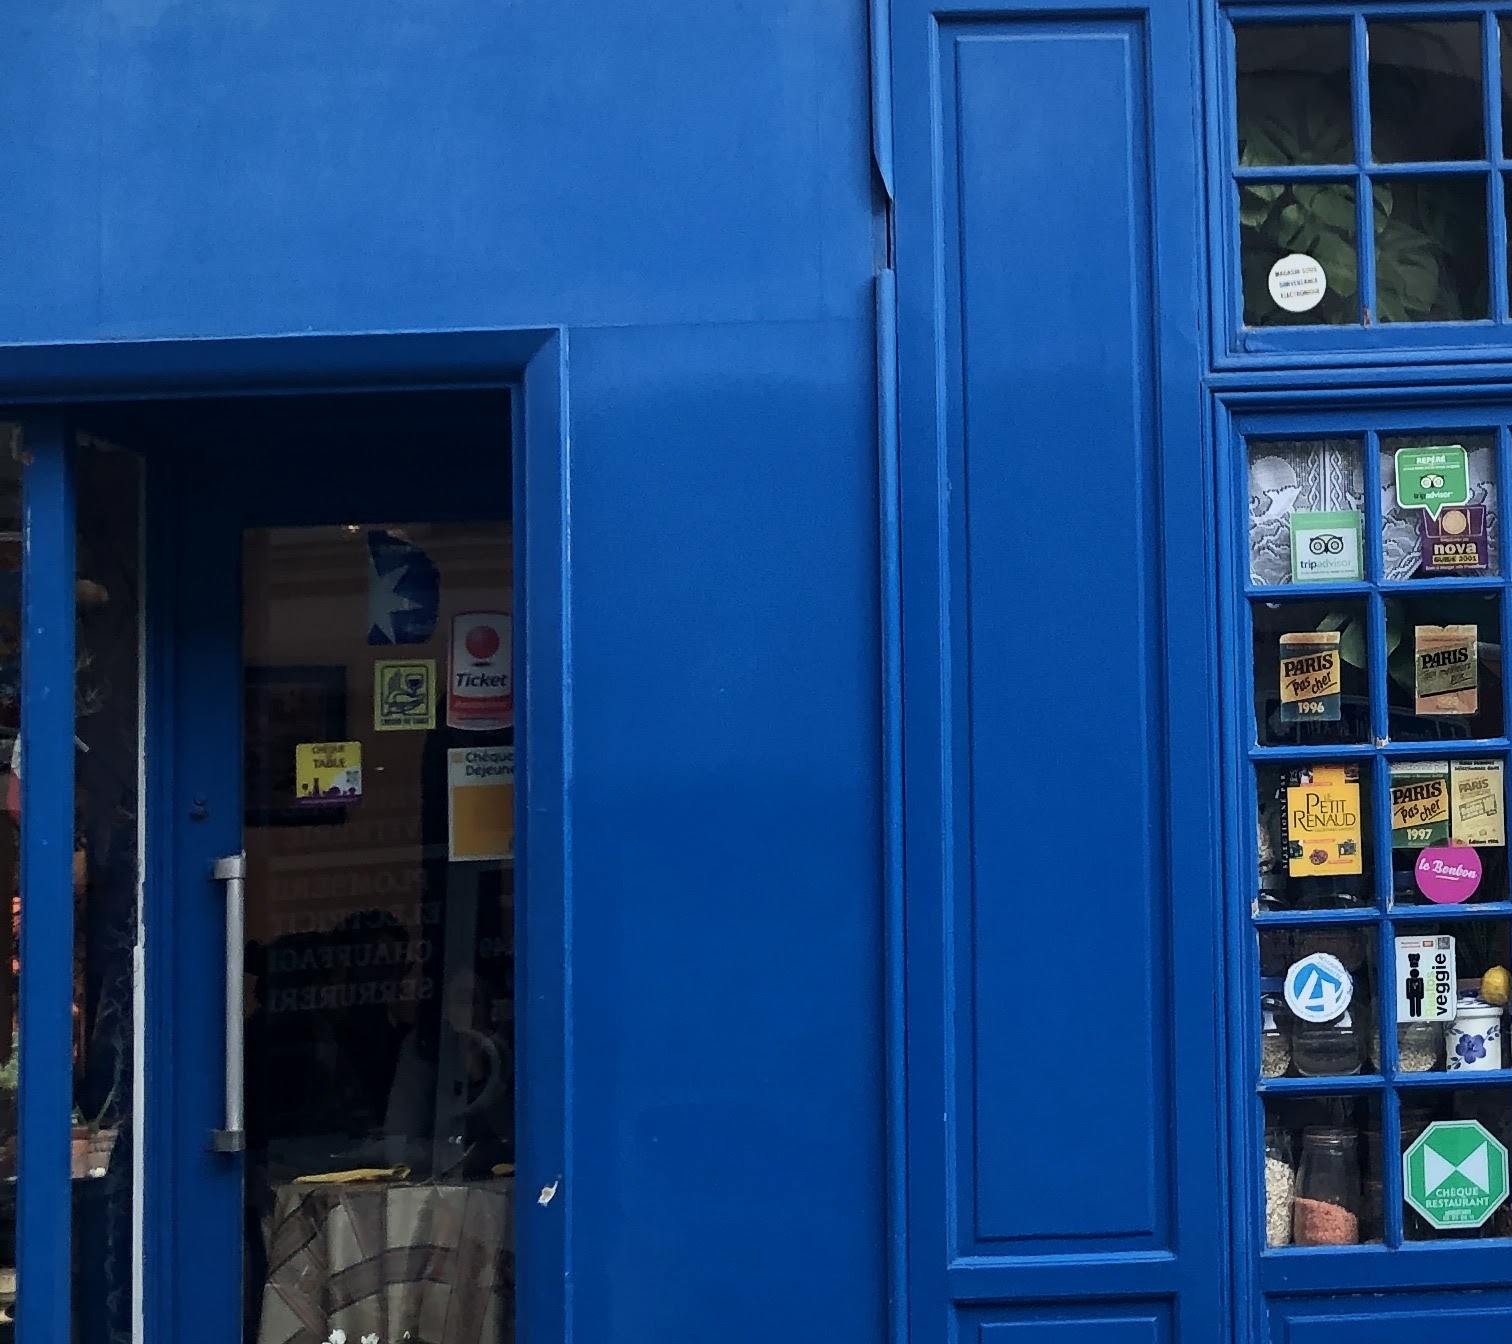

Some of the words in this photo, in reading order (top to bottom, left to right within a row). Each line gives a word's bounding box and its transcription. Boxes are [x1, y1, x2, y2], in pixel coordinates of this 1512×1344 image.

[1413, 490, 1454, 501] tripadvisor
[1433, 542, 1477, 556] nova
[1299, 558, 1352, 571] tripadvisor
[1458, 555, 1478, 563] 2001
[1283, 653, 1334, 678] PARIS
[1421, 646, 1469, 670] PARIS
[456, 672, 507, 688] Ticket
[1311, 671, 1333, 695] cher
[1297, 701, 1325, 714] 1996
[1392, 780, 1443, 805] PARIS
[1458, 778, 1489, 793] PARIS
[1305, 792, 1347, 815] PETIT
[1419, 799, 1441, 822] cher
[1293, 810, 1357, 832] RENAUD
[1406, 828, 1433, 841] 1997
[1432, 859, 1478, 879] Bonbon
[1431, 952, 1451, 1017] veggie
[1425, 1197, 1490, 1208] RESTAURANT
